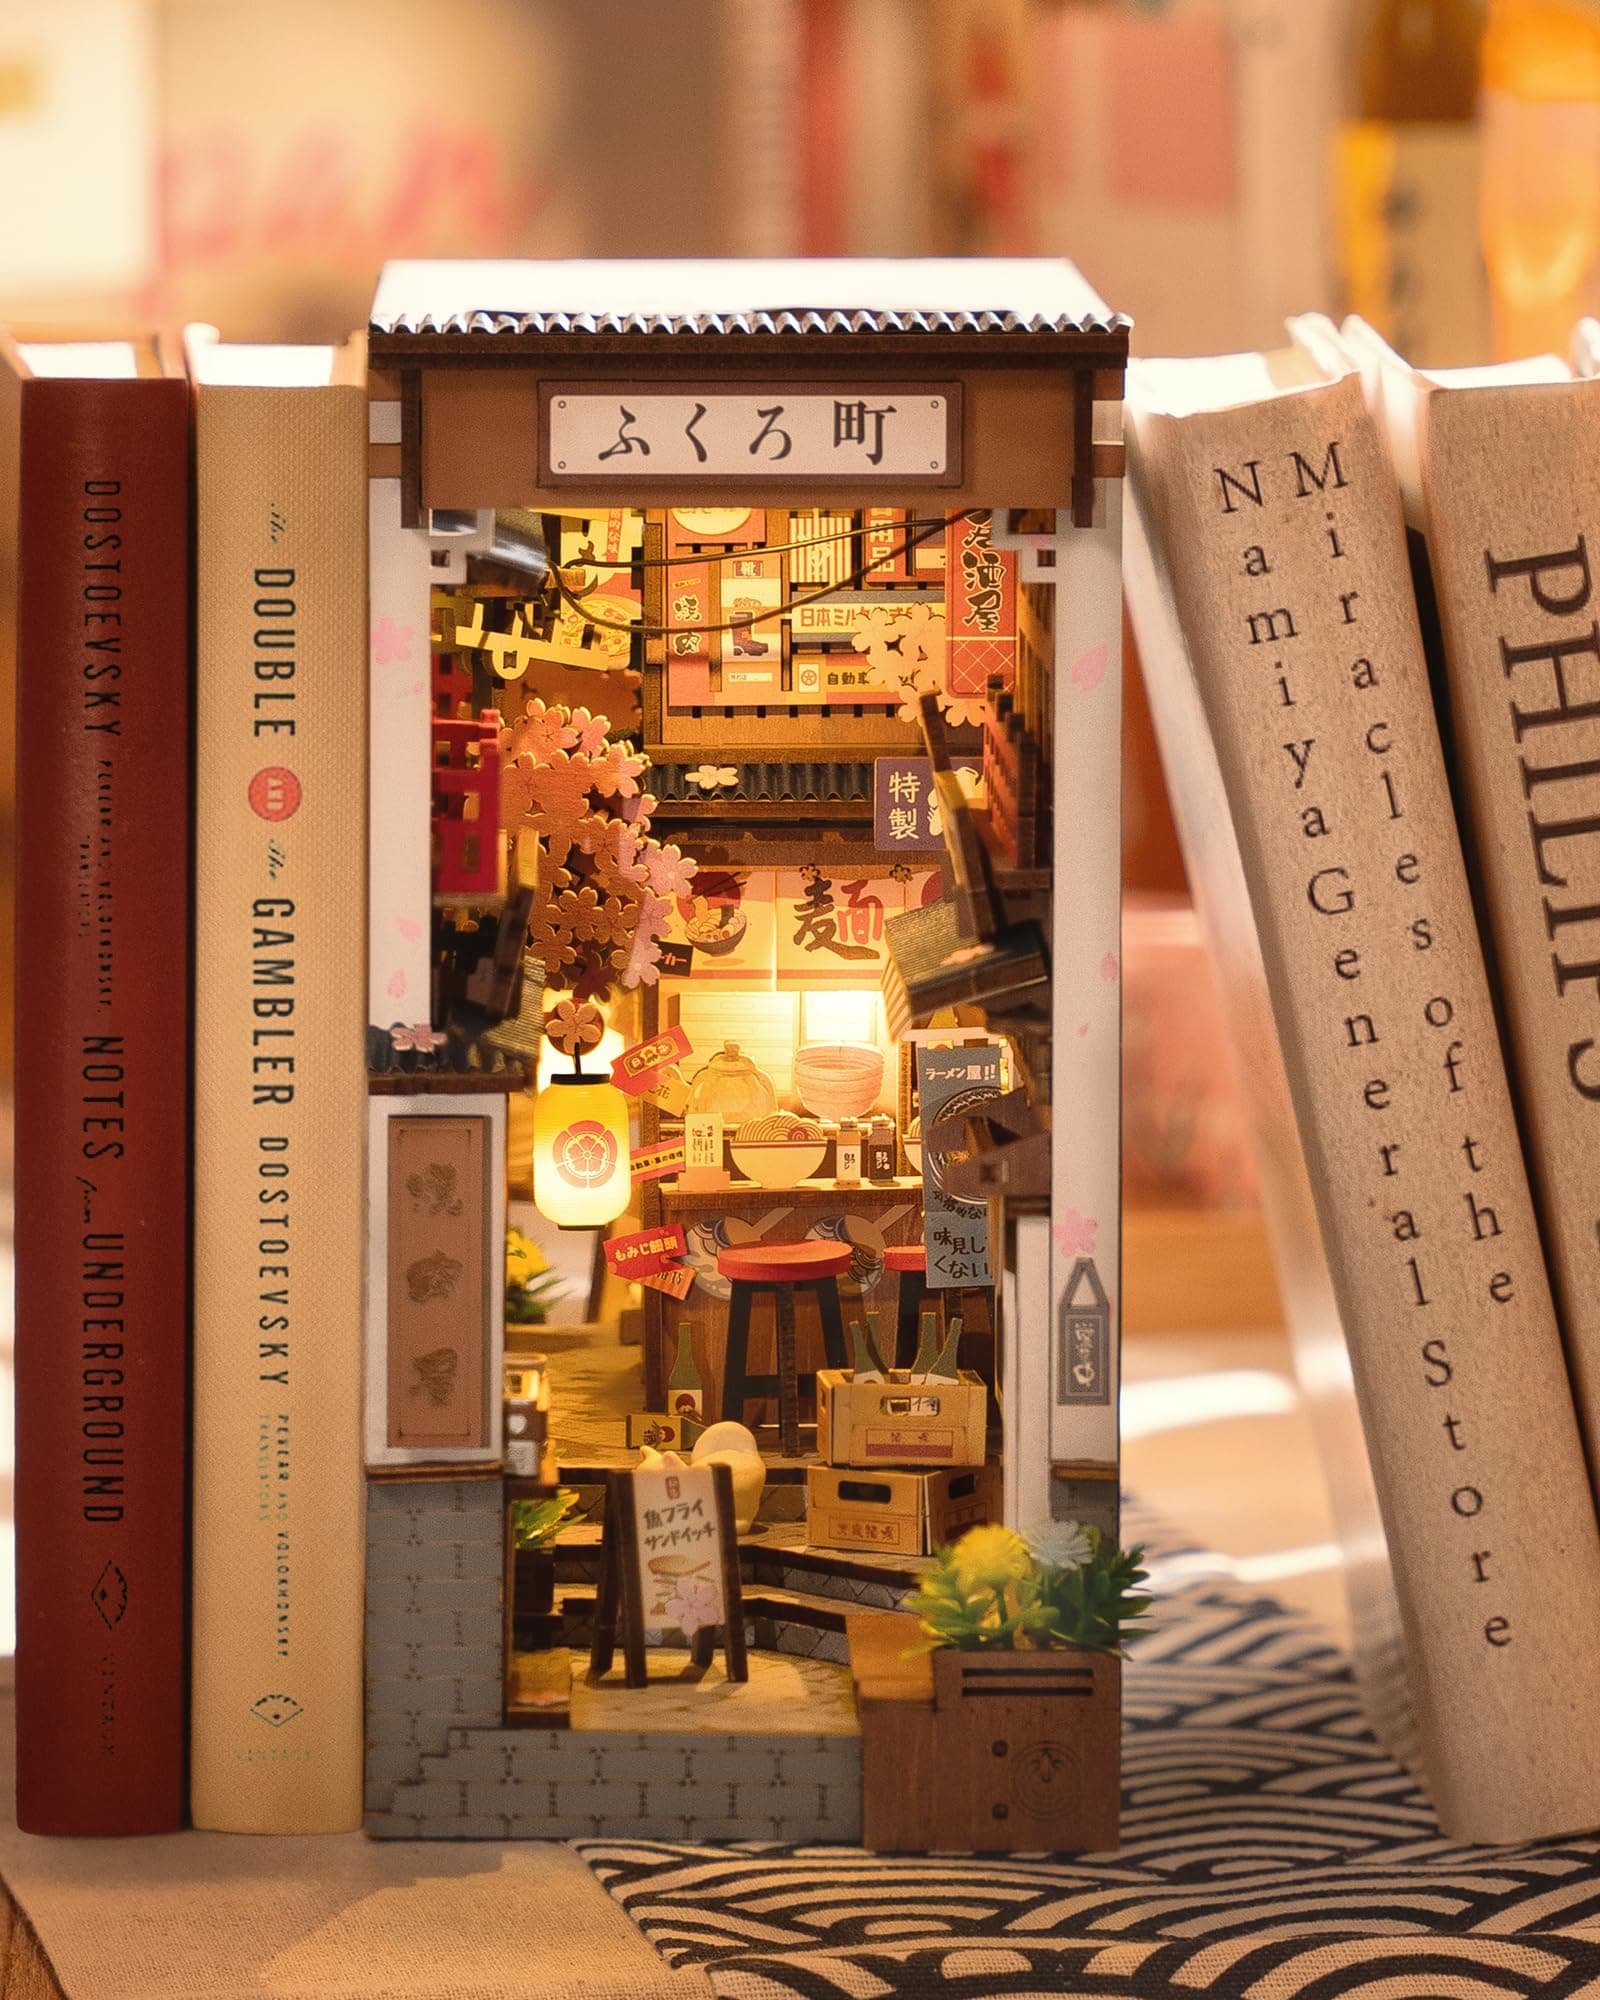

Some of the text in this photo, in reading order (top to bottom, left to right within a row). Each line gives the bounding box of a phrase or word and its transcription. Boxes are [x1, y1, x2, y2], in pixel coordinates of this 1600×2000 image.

[597, 398, 898, 466] ふくろ町
[83, 480, 121, 738] DOSTOEVSKY
[253, 568, 297, 738] DOUBLE
[265, 777, 285, 812] AND
[888, 771, 921, 841] 特製
[267, 838, 287, 880] The
[1289, 440, 1516, 1302] Miracles of the
[252, 897, 297, 1107] GAMBLER
[82, 1035, 125, 1161] NOTES
[258, 1136, 290, 1389] DOSTOEVSKY
[933, 1227, 988, 1255] 味見し
[82, 1233, 125, 1524] UNDERGROUND
[643, 1498, 704, 1530] 魚フライ
[643, 1520, 717, 1551] サンドイッチ
